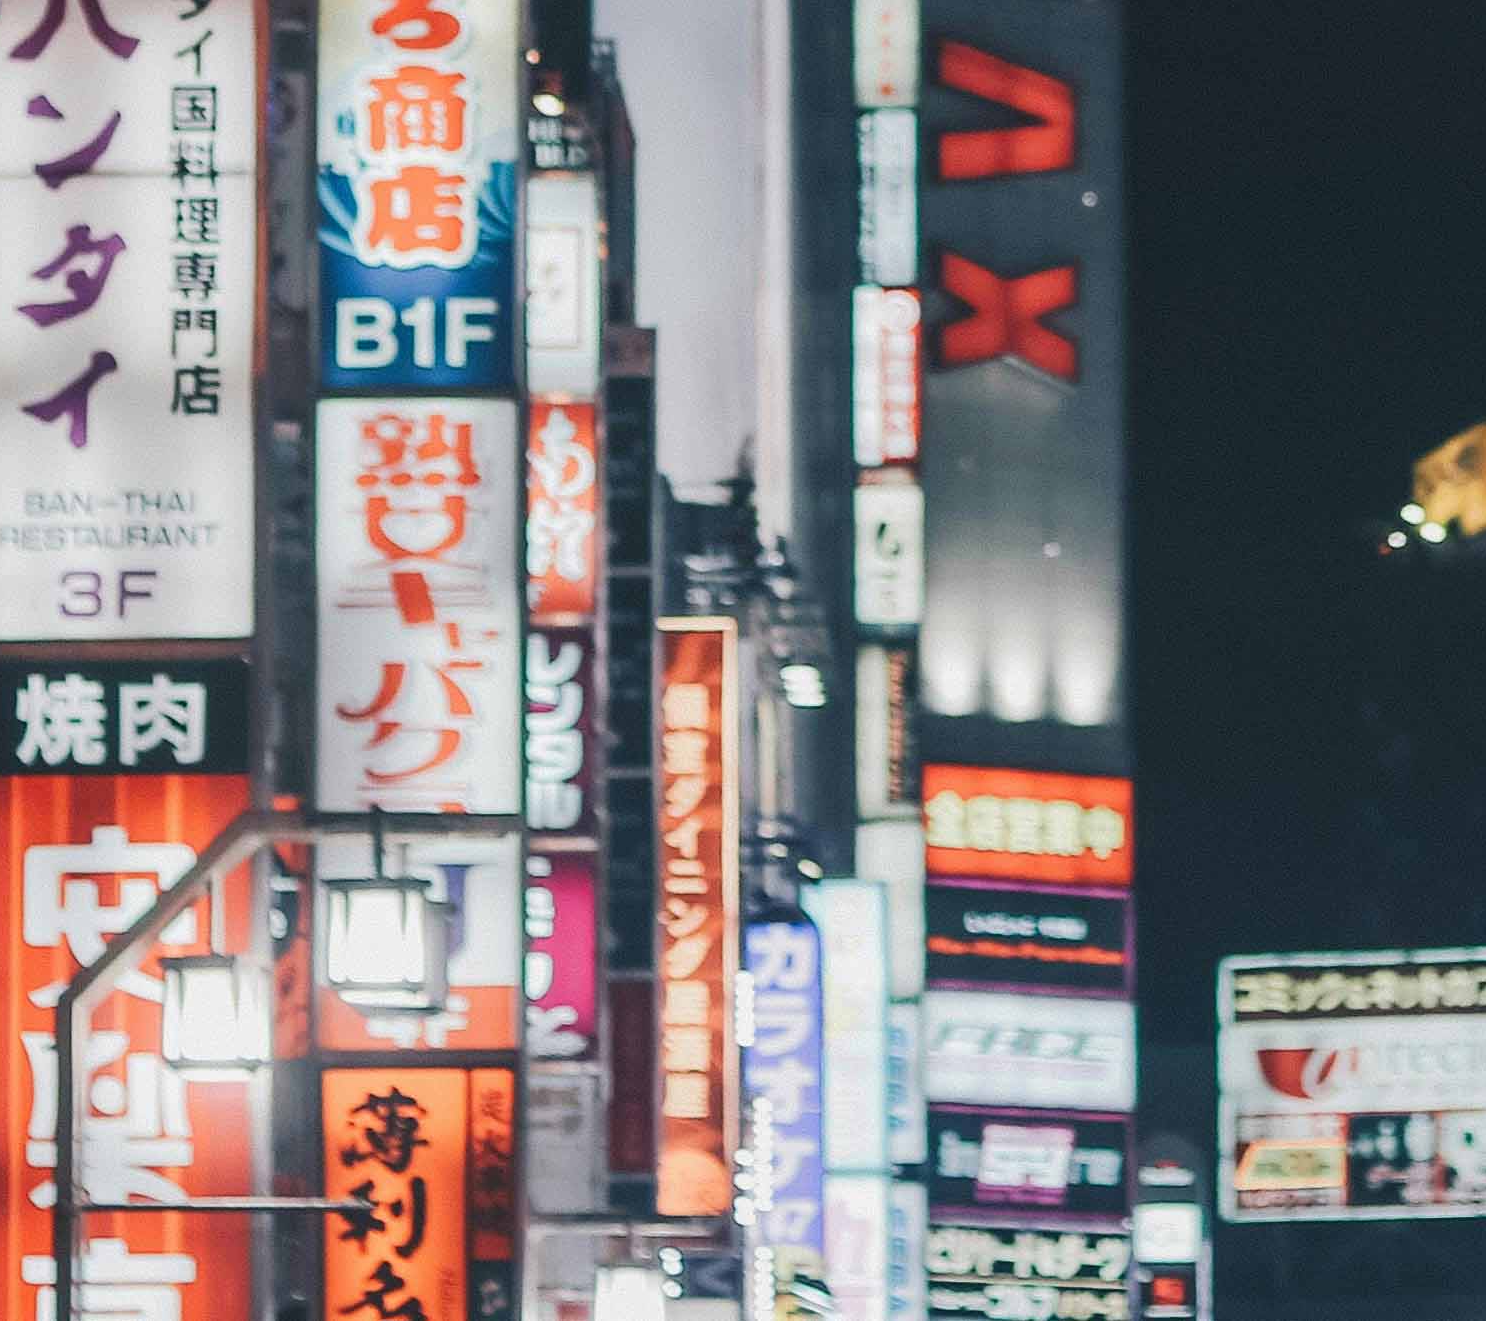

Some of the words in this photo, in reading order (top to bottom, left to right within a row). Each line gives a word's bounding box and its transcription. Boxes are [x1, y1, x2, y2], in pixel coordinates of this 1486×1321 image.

[334, 297, 501, 370] B1F
[59, 570, 158, 619] 3F
[15, 673, 210, 768] 焼肉
